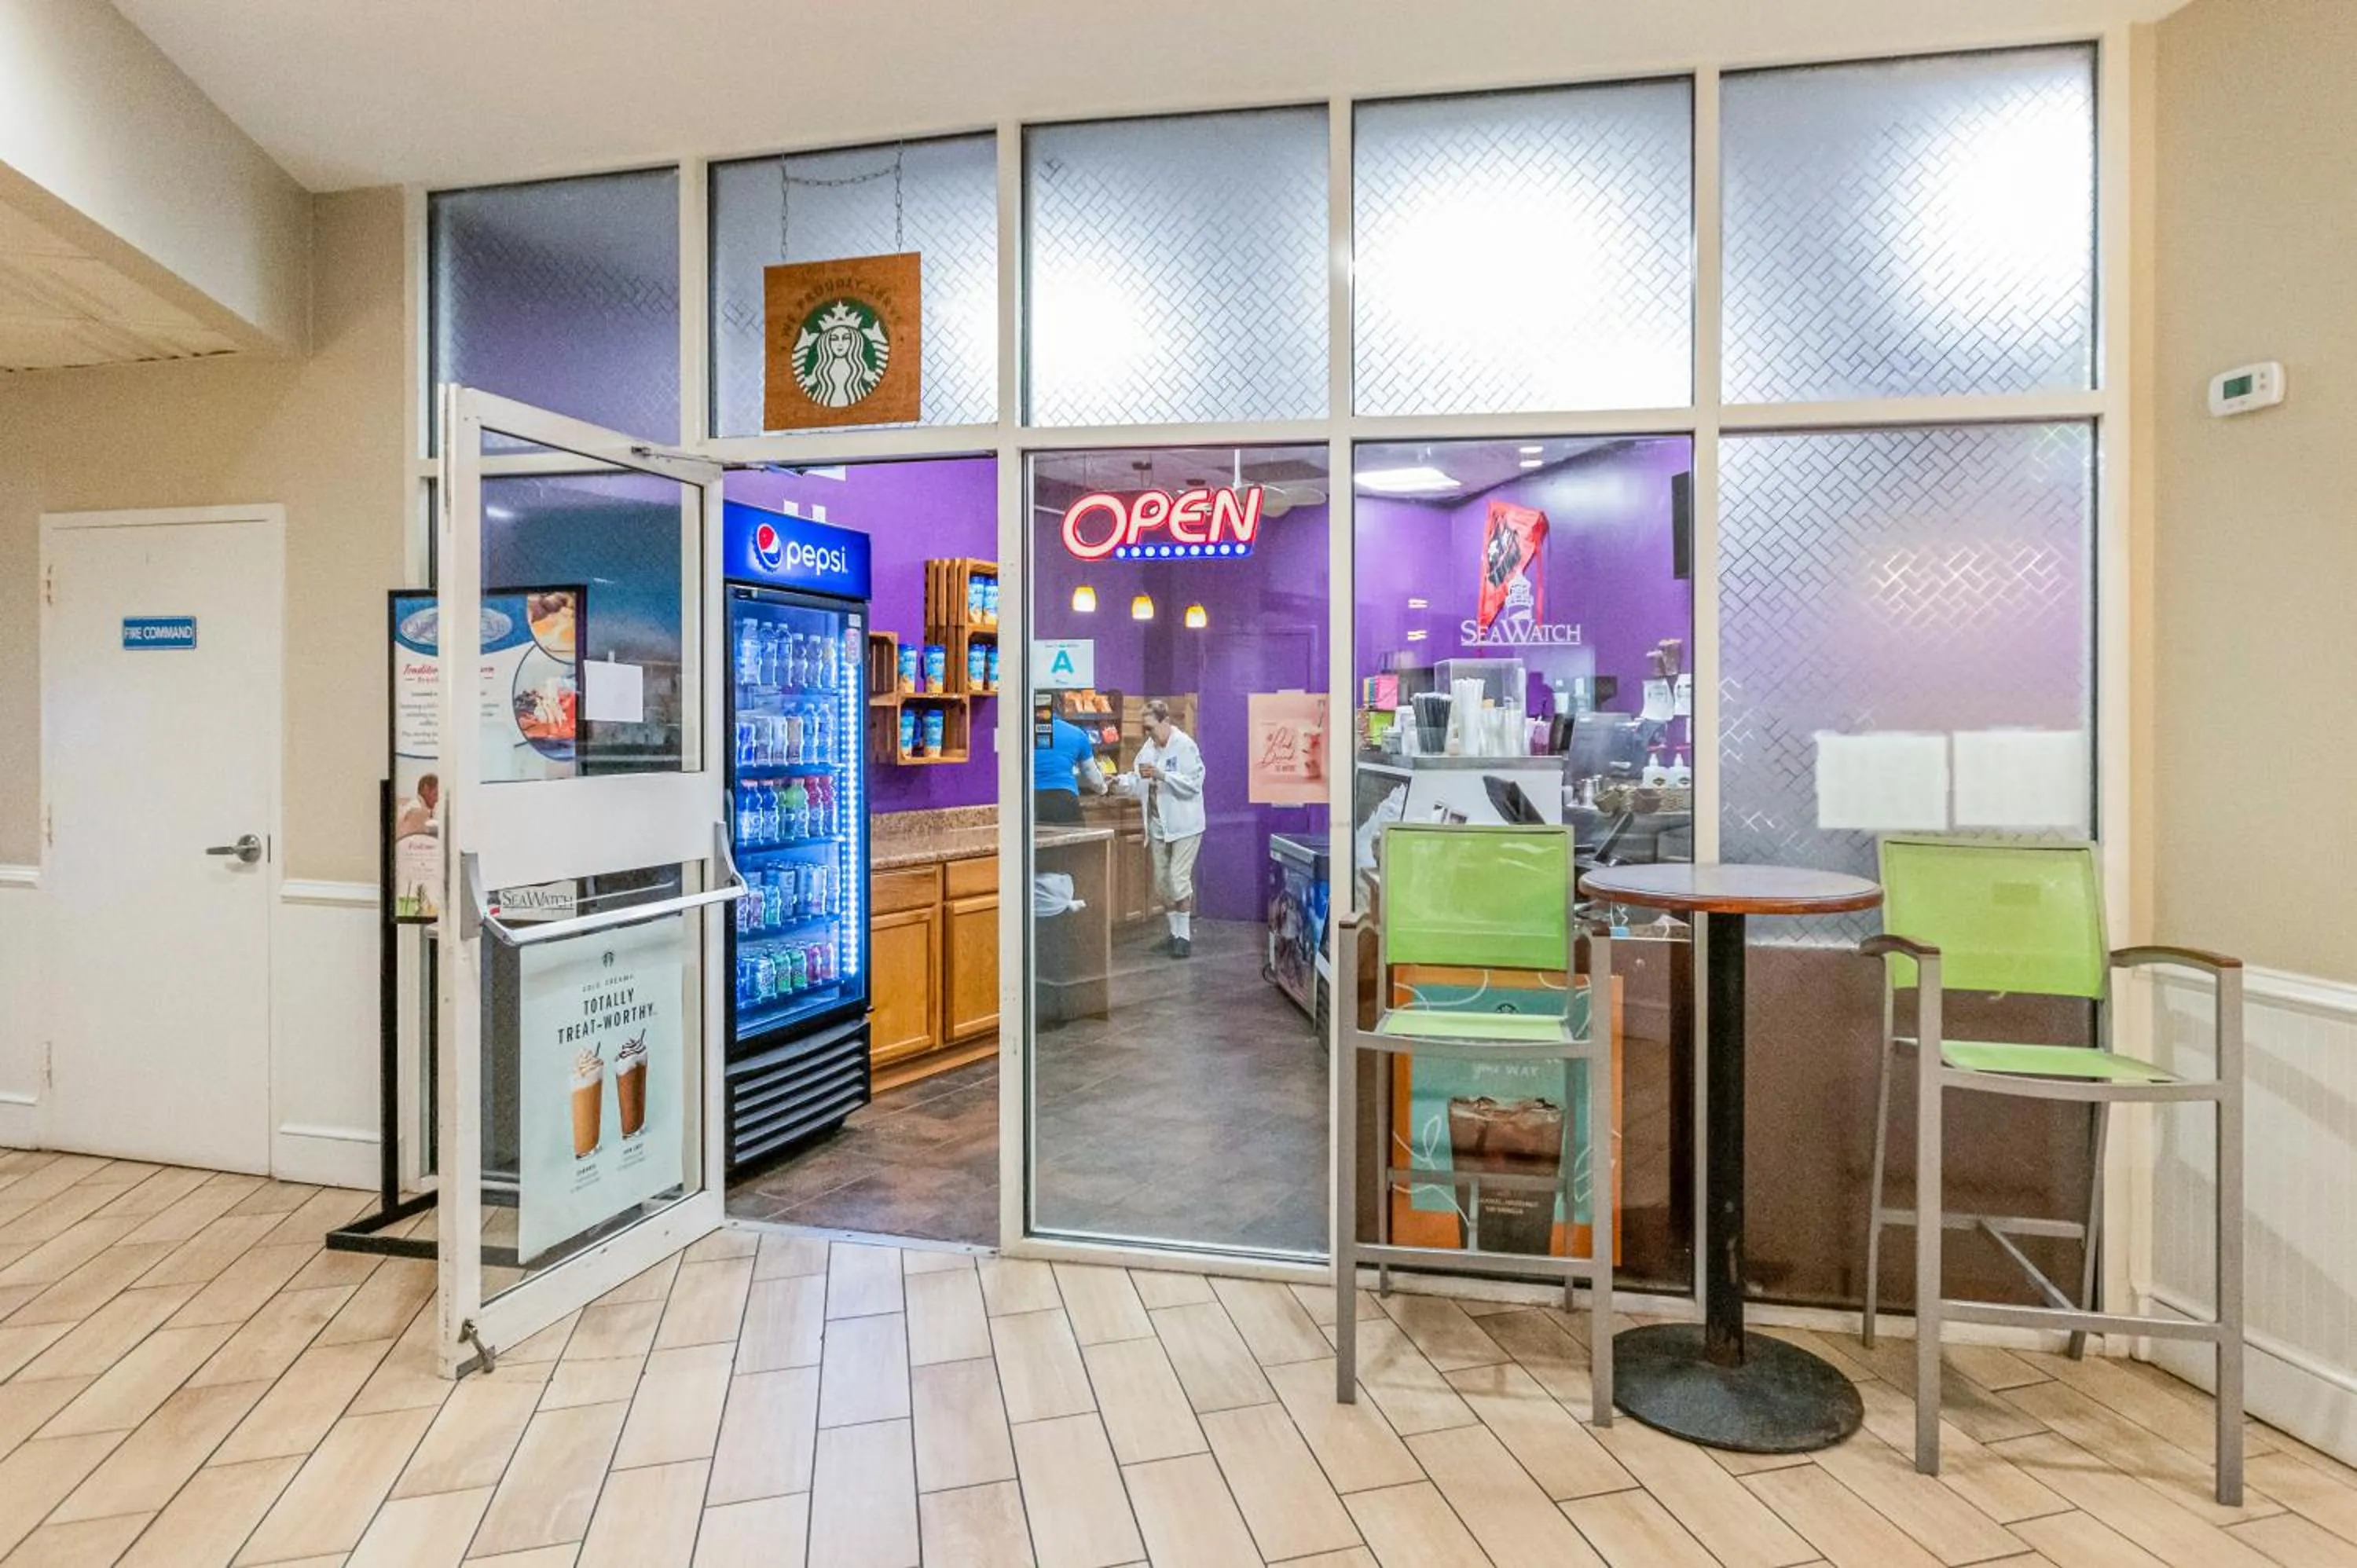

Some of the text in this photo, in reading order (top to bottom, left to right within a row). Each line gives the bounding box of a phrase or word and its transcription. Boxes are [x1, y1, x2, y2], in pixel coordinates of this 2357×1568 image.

[1061, 484, 1263, 562] OPEN
[786, 540, 846, 576] pepsi
[143, 625, 192, 639] COMMAND
[1051, 649, 1075, 674] A
[584, 987, 635, 1016] TOTALLY
